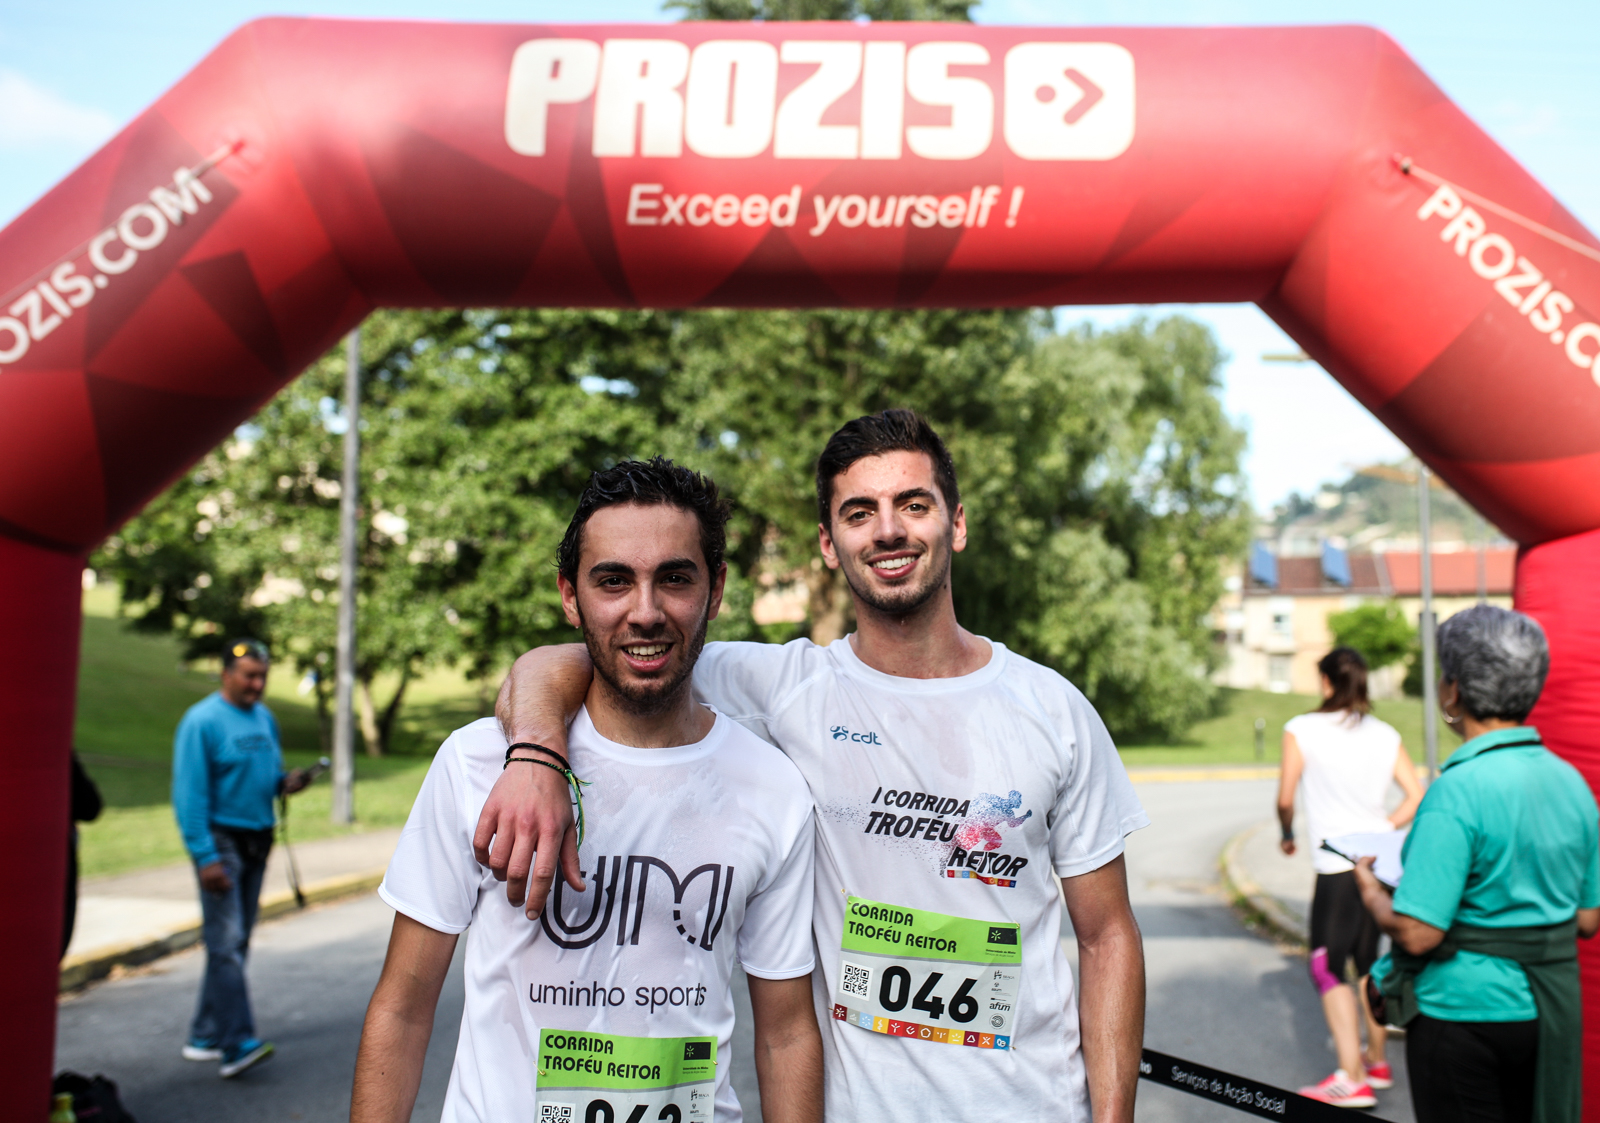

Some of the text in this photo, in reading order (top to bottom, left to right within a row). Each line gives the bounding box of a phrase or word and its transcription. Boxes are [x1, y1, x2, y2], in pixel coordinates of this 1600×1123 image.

[503, 38, 994, 160] PROZIS
[626, 183, 802, 227] Exceed
[809, 185, 1002, 237] yourself
[1416, 183, 1600, 388] PROZIS.C
[851, 732, 882, 746] cdt
[871, 786, 971, 818] I CORRIDA
[864, 811, 959, 842] TROFÉU
[947, 846, 1028, 877] REITOR
[851, 902, 914, 926] CORRIDA
[848, 920, 957, 953] TROFÉU REITOR
[529, 981, 707, 1014] uminho sports
[879, 965, 979, 1023] 046
[545, 1035, 614, 1055] CORRIDA
[543, 1055, 661, 1080] TROFÉU REITOR
[1171, 1065, 1286, 1115] Serviços de Acção Social
